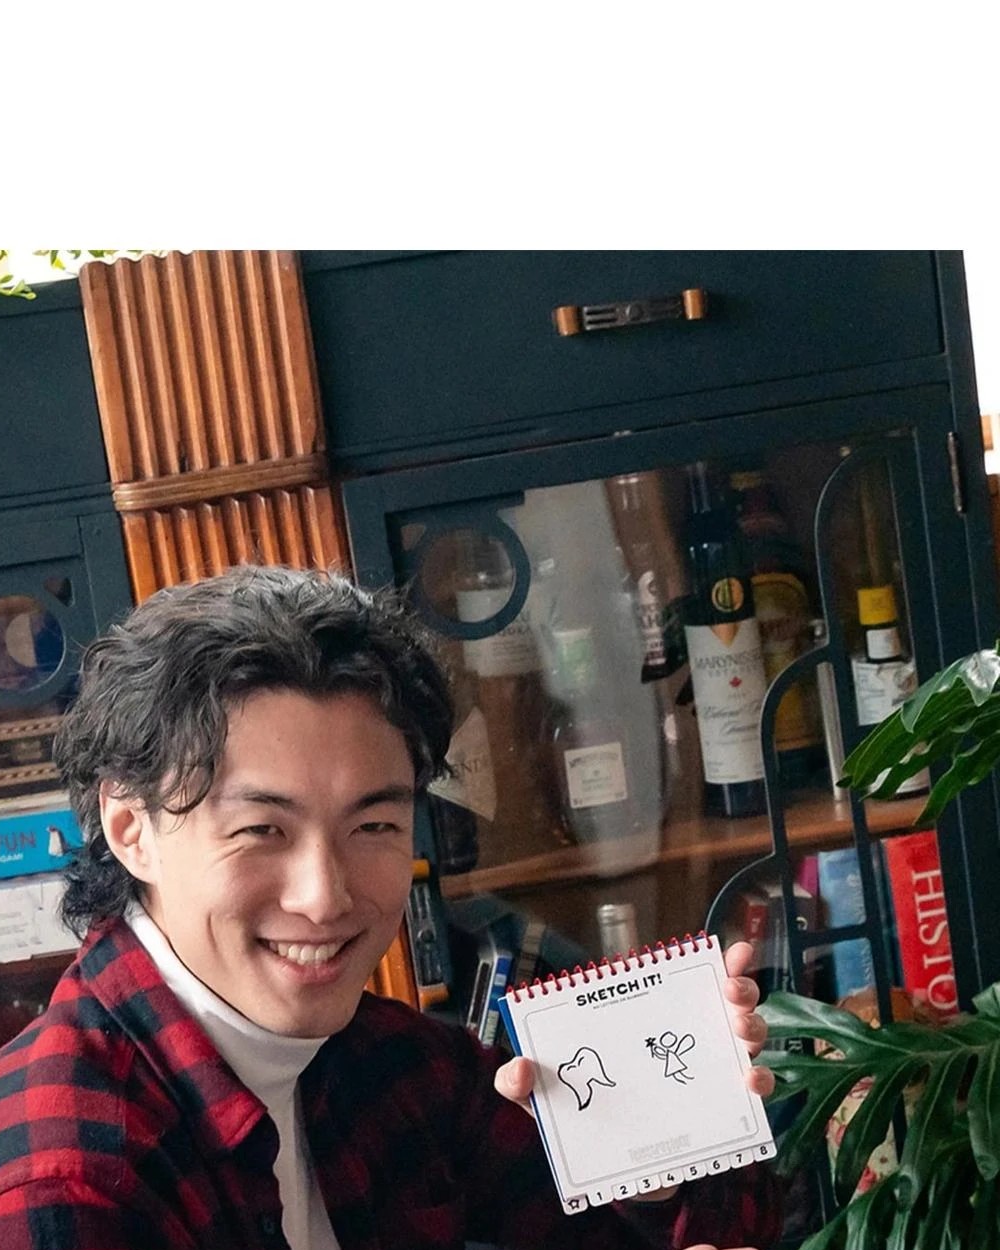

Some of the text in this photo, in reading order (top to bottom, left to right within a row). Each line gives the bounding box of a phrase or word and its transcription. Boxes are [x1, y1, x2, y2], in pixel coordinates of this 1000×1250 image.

[576, 972, 663, 1007] SKETCH IT!
[597, 1145, 769, 1201] 1 2 3 4 5 6 7 8
